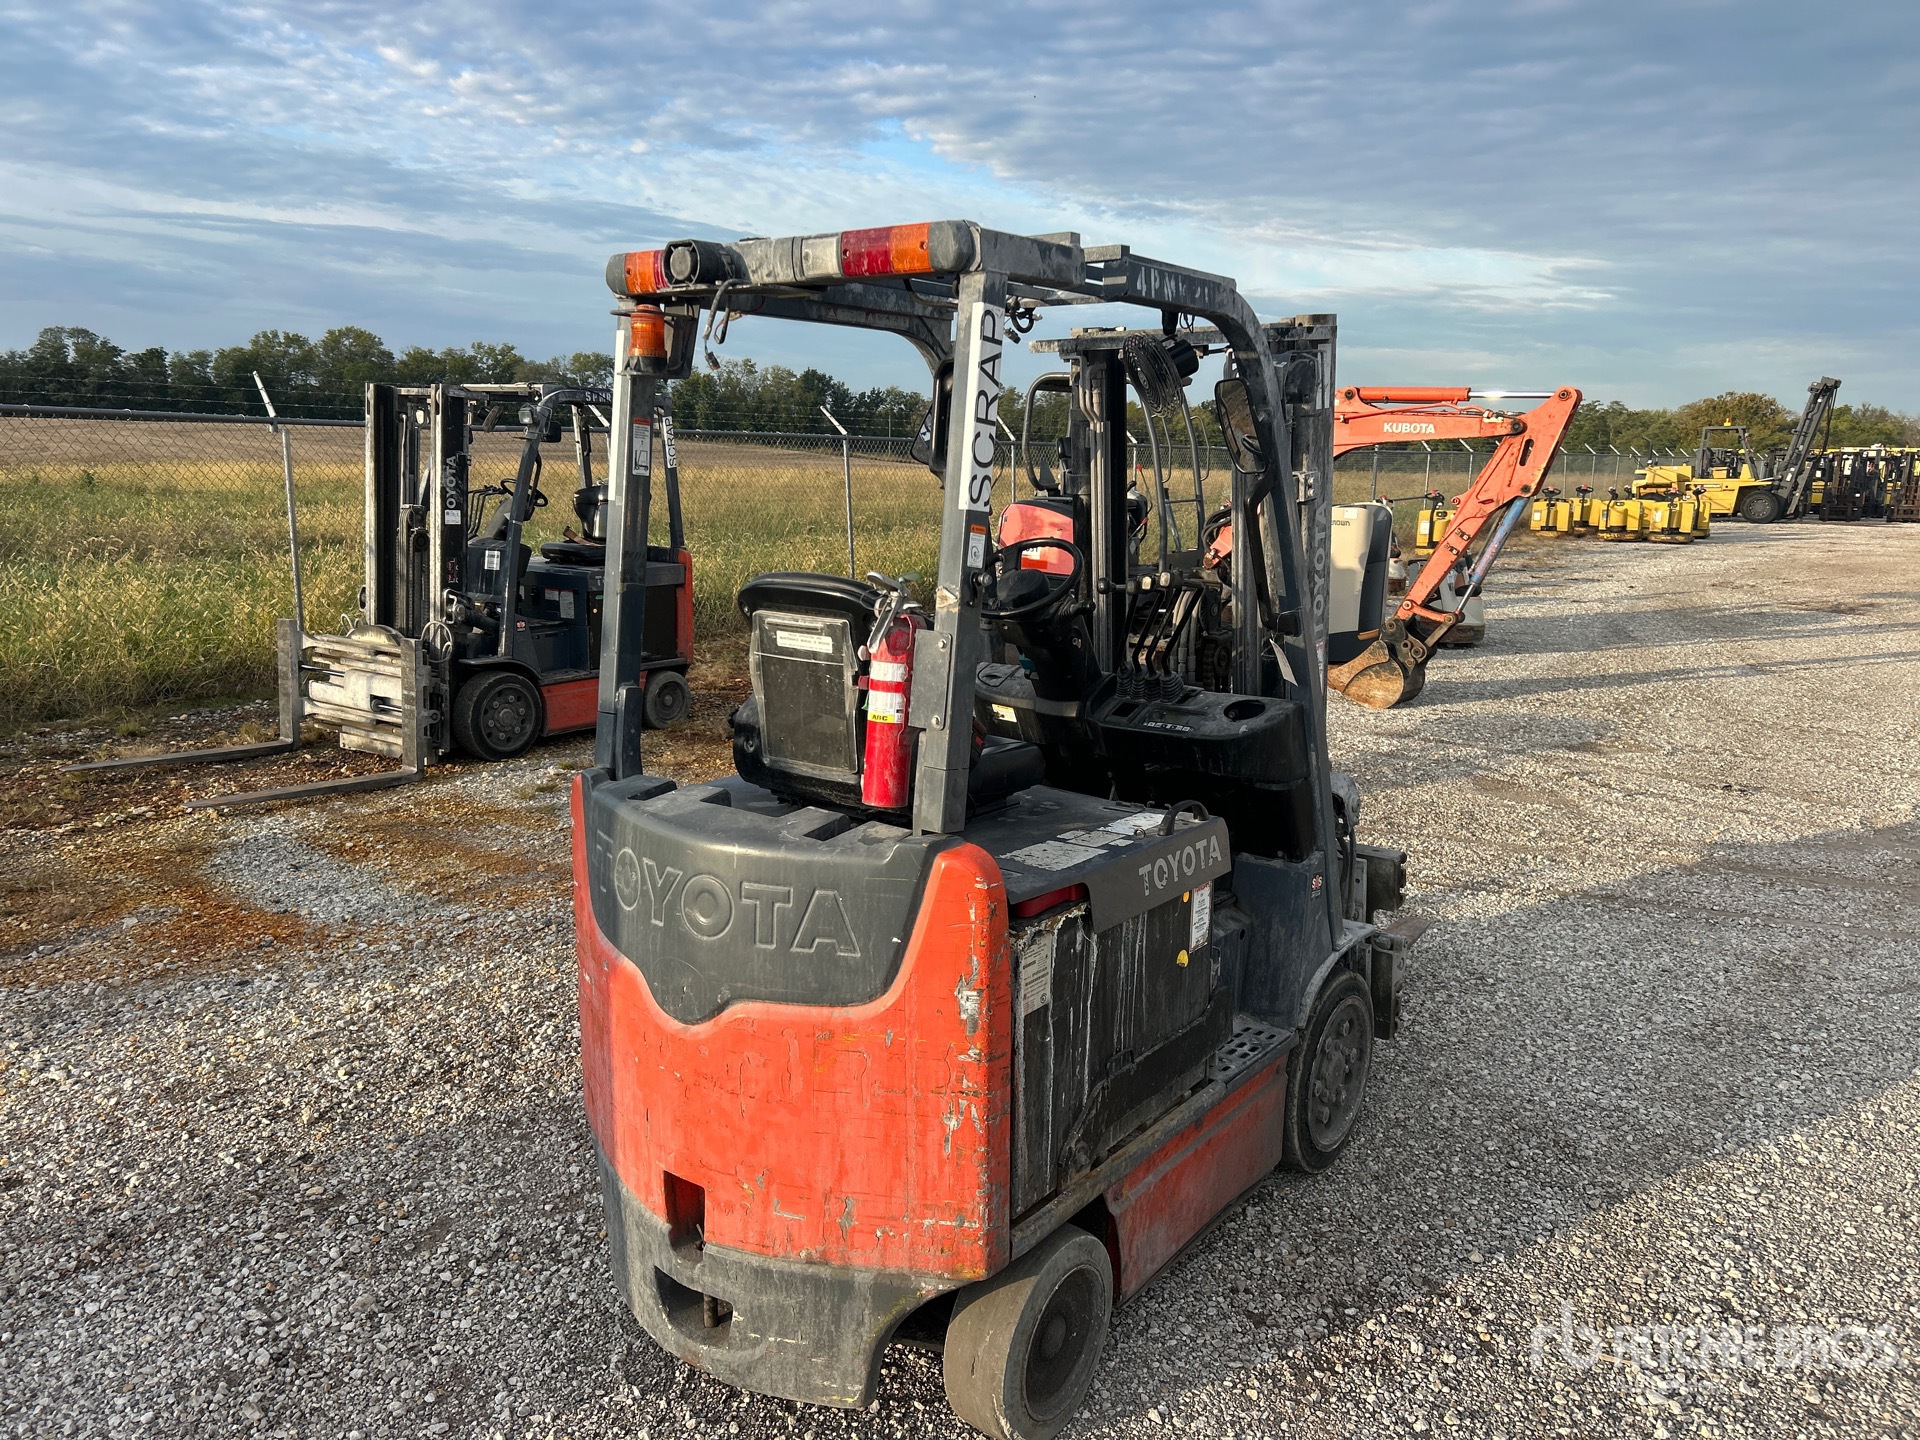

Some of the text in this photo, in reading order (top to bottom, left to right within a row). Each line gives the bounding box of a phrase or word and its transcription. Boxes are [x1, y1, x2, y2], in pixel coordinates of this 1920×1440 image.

[967, 309, 1003, 507] SCRAP
[1383, 422, 1436, 434] KUBOTA
[665, 417, 677, 467] SCRAP
[446, 455, 457, 509] OYOTA
[871, 714, 889, 722] ABC
[1138, 834, 1223, 897] TOYOTA
